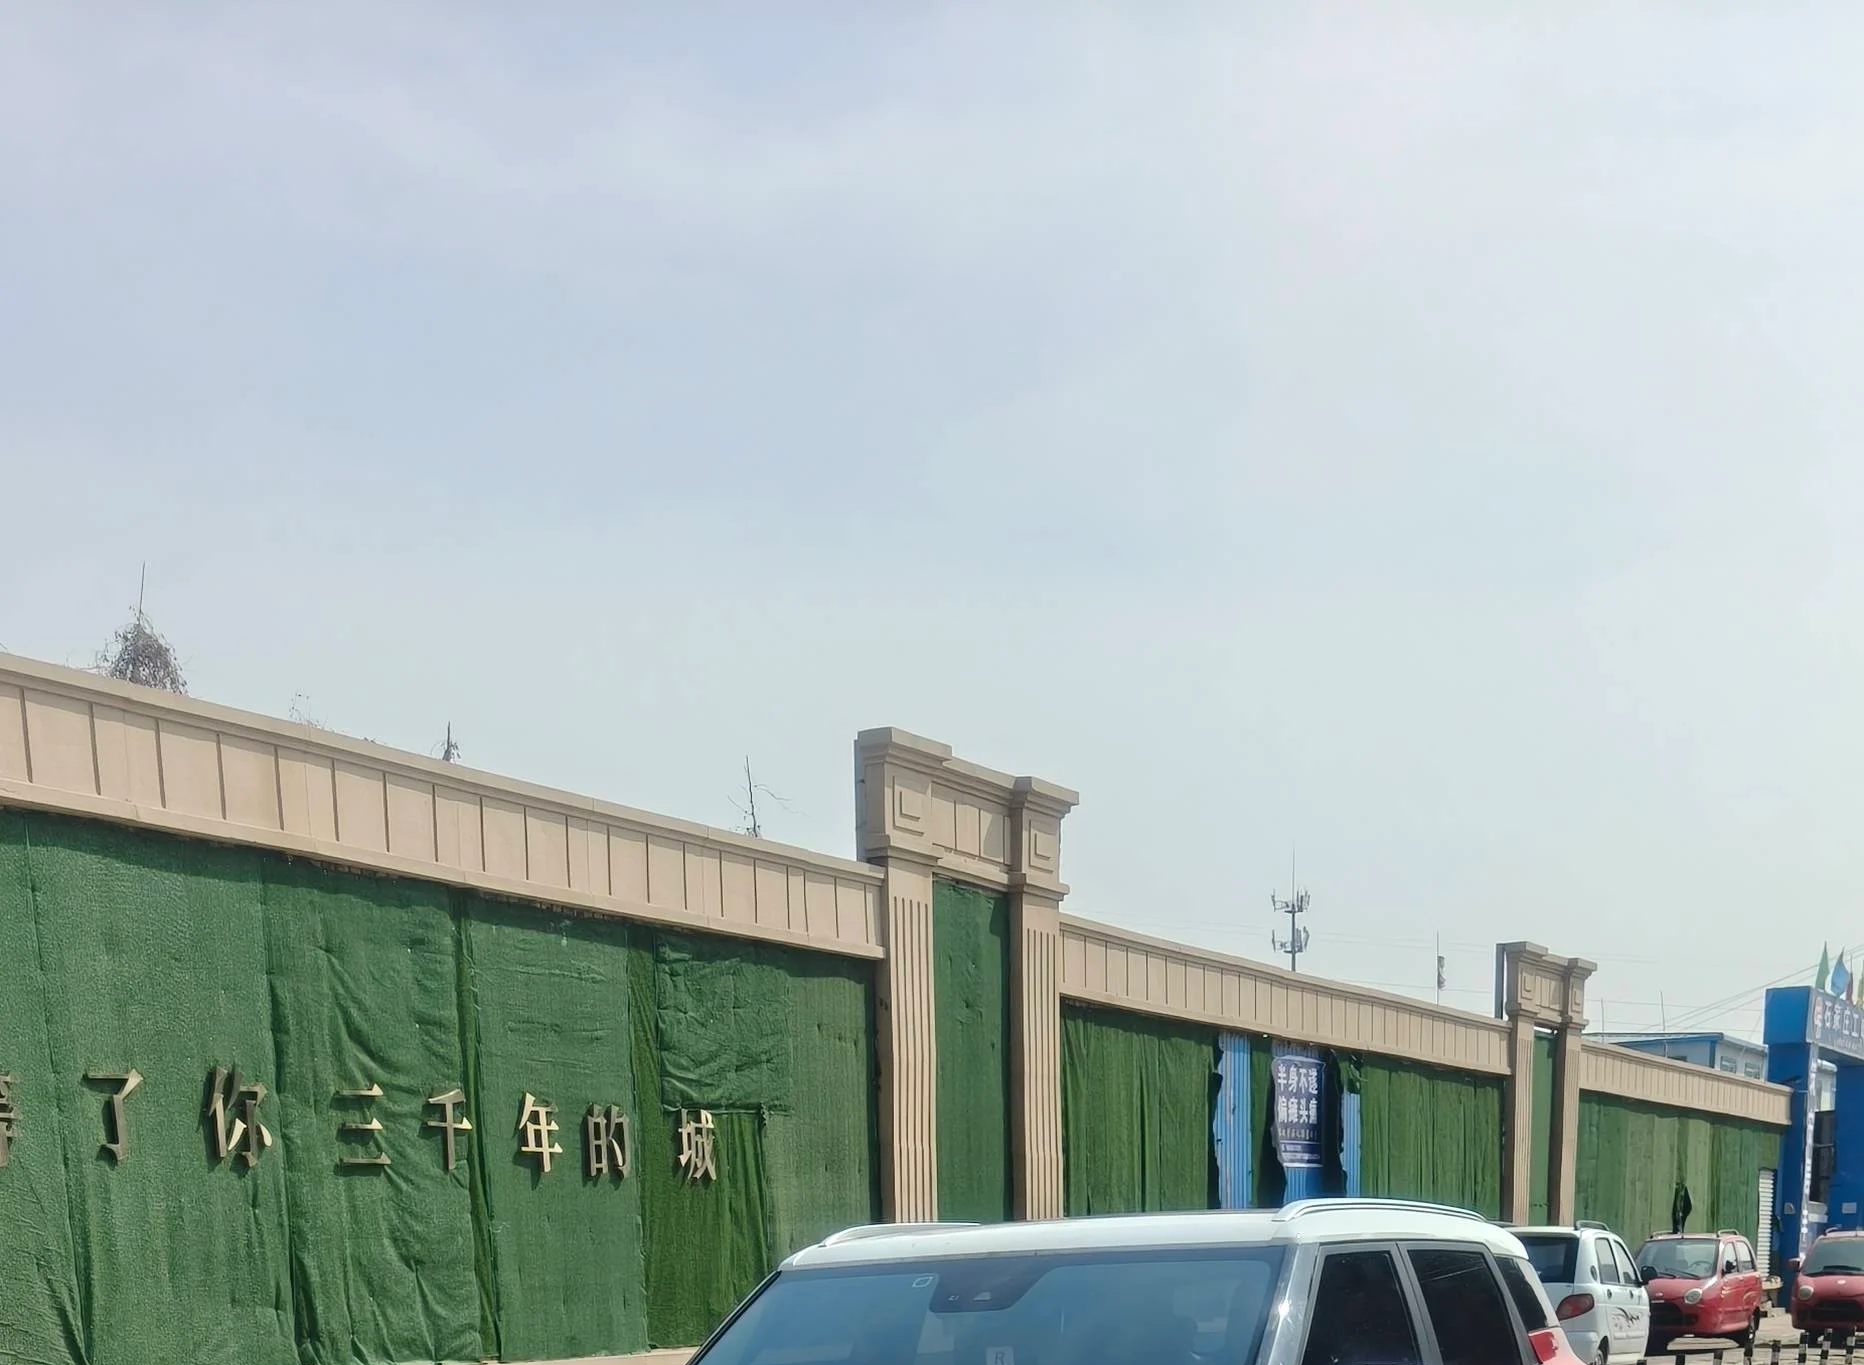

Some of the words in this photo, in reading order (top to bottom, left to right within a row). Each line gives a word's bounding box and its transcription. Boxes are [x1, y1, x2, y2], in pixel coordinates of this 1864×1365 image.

[1824, 1001, 1864, 1038] 石家庄工
[1277, 1064, 1318, 1094] 半身不遂
